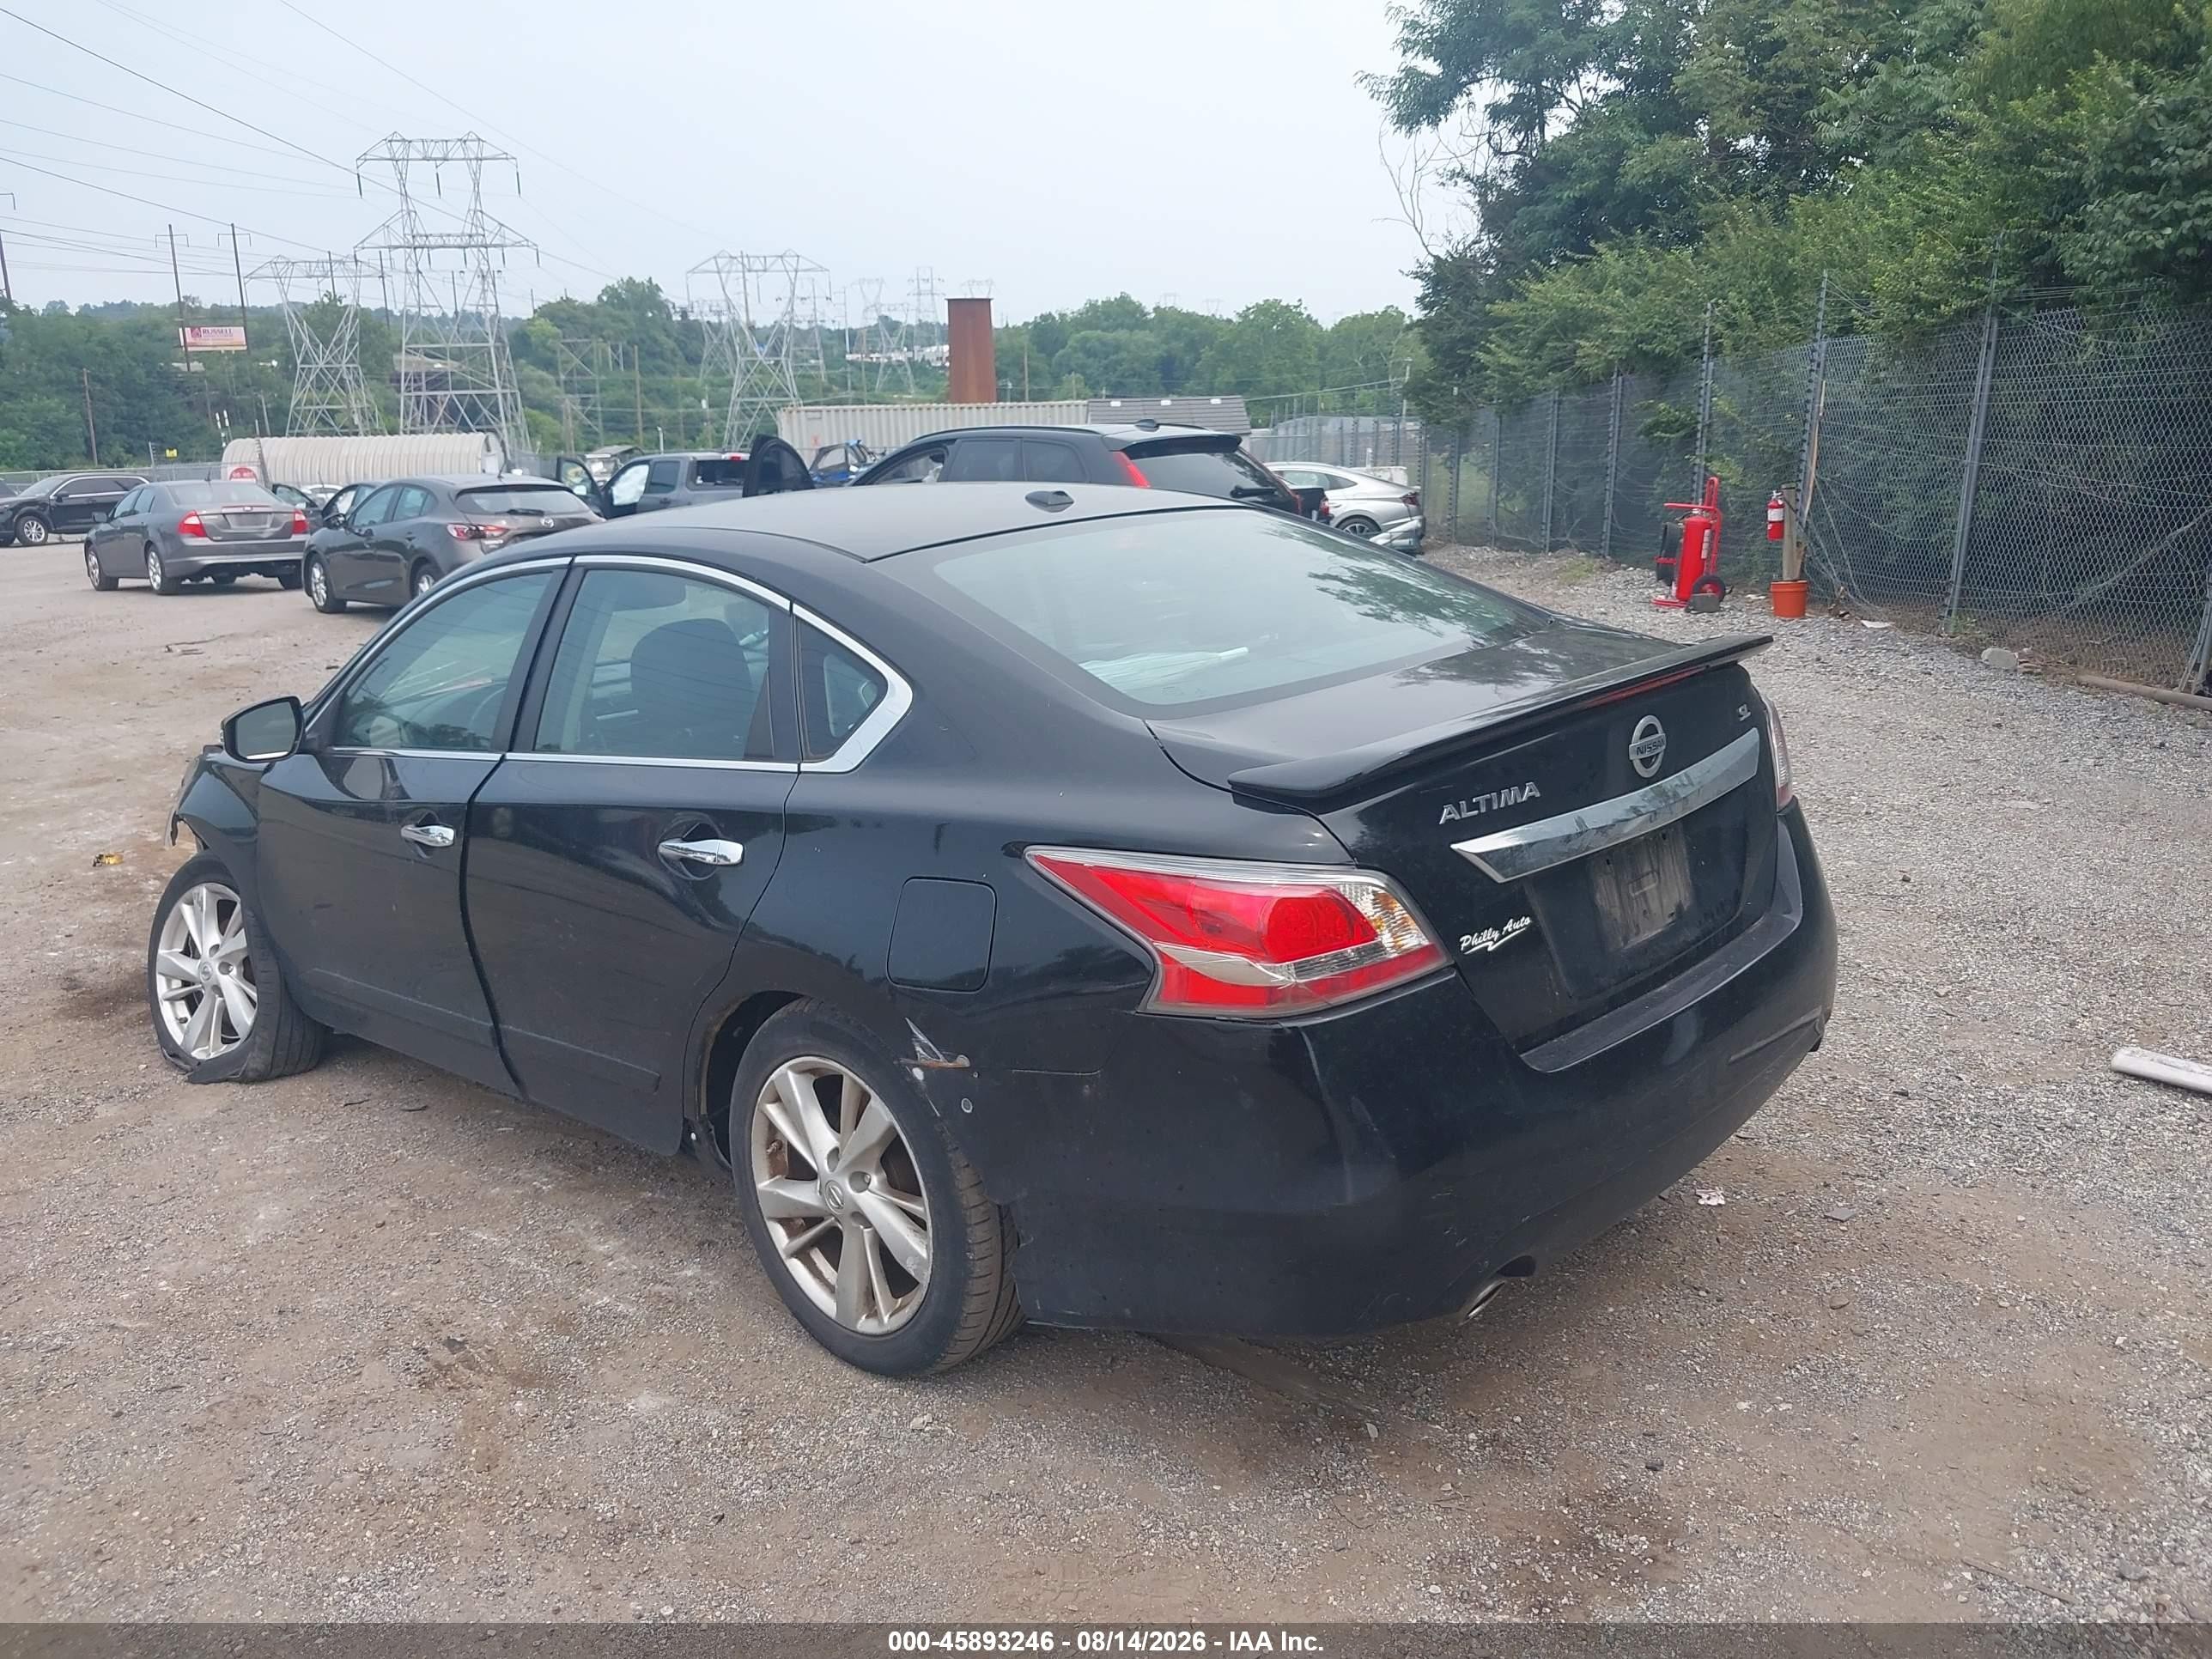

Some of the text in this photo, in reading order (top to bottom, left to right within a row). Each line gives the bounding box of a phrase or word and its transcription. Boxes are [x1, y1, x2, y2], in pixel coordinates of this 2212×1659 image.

[1636, 738, 1666, 757] NISSAN
[1439, 781, 1541, 825] ALTIMA
[1460, 916, 1532, 951] Philly Auto
